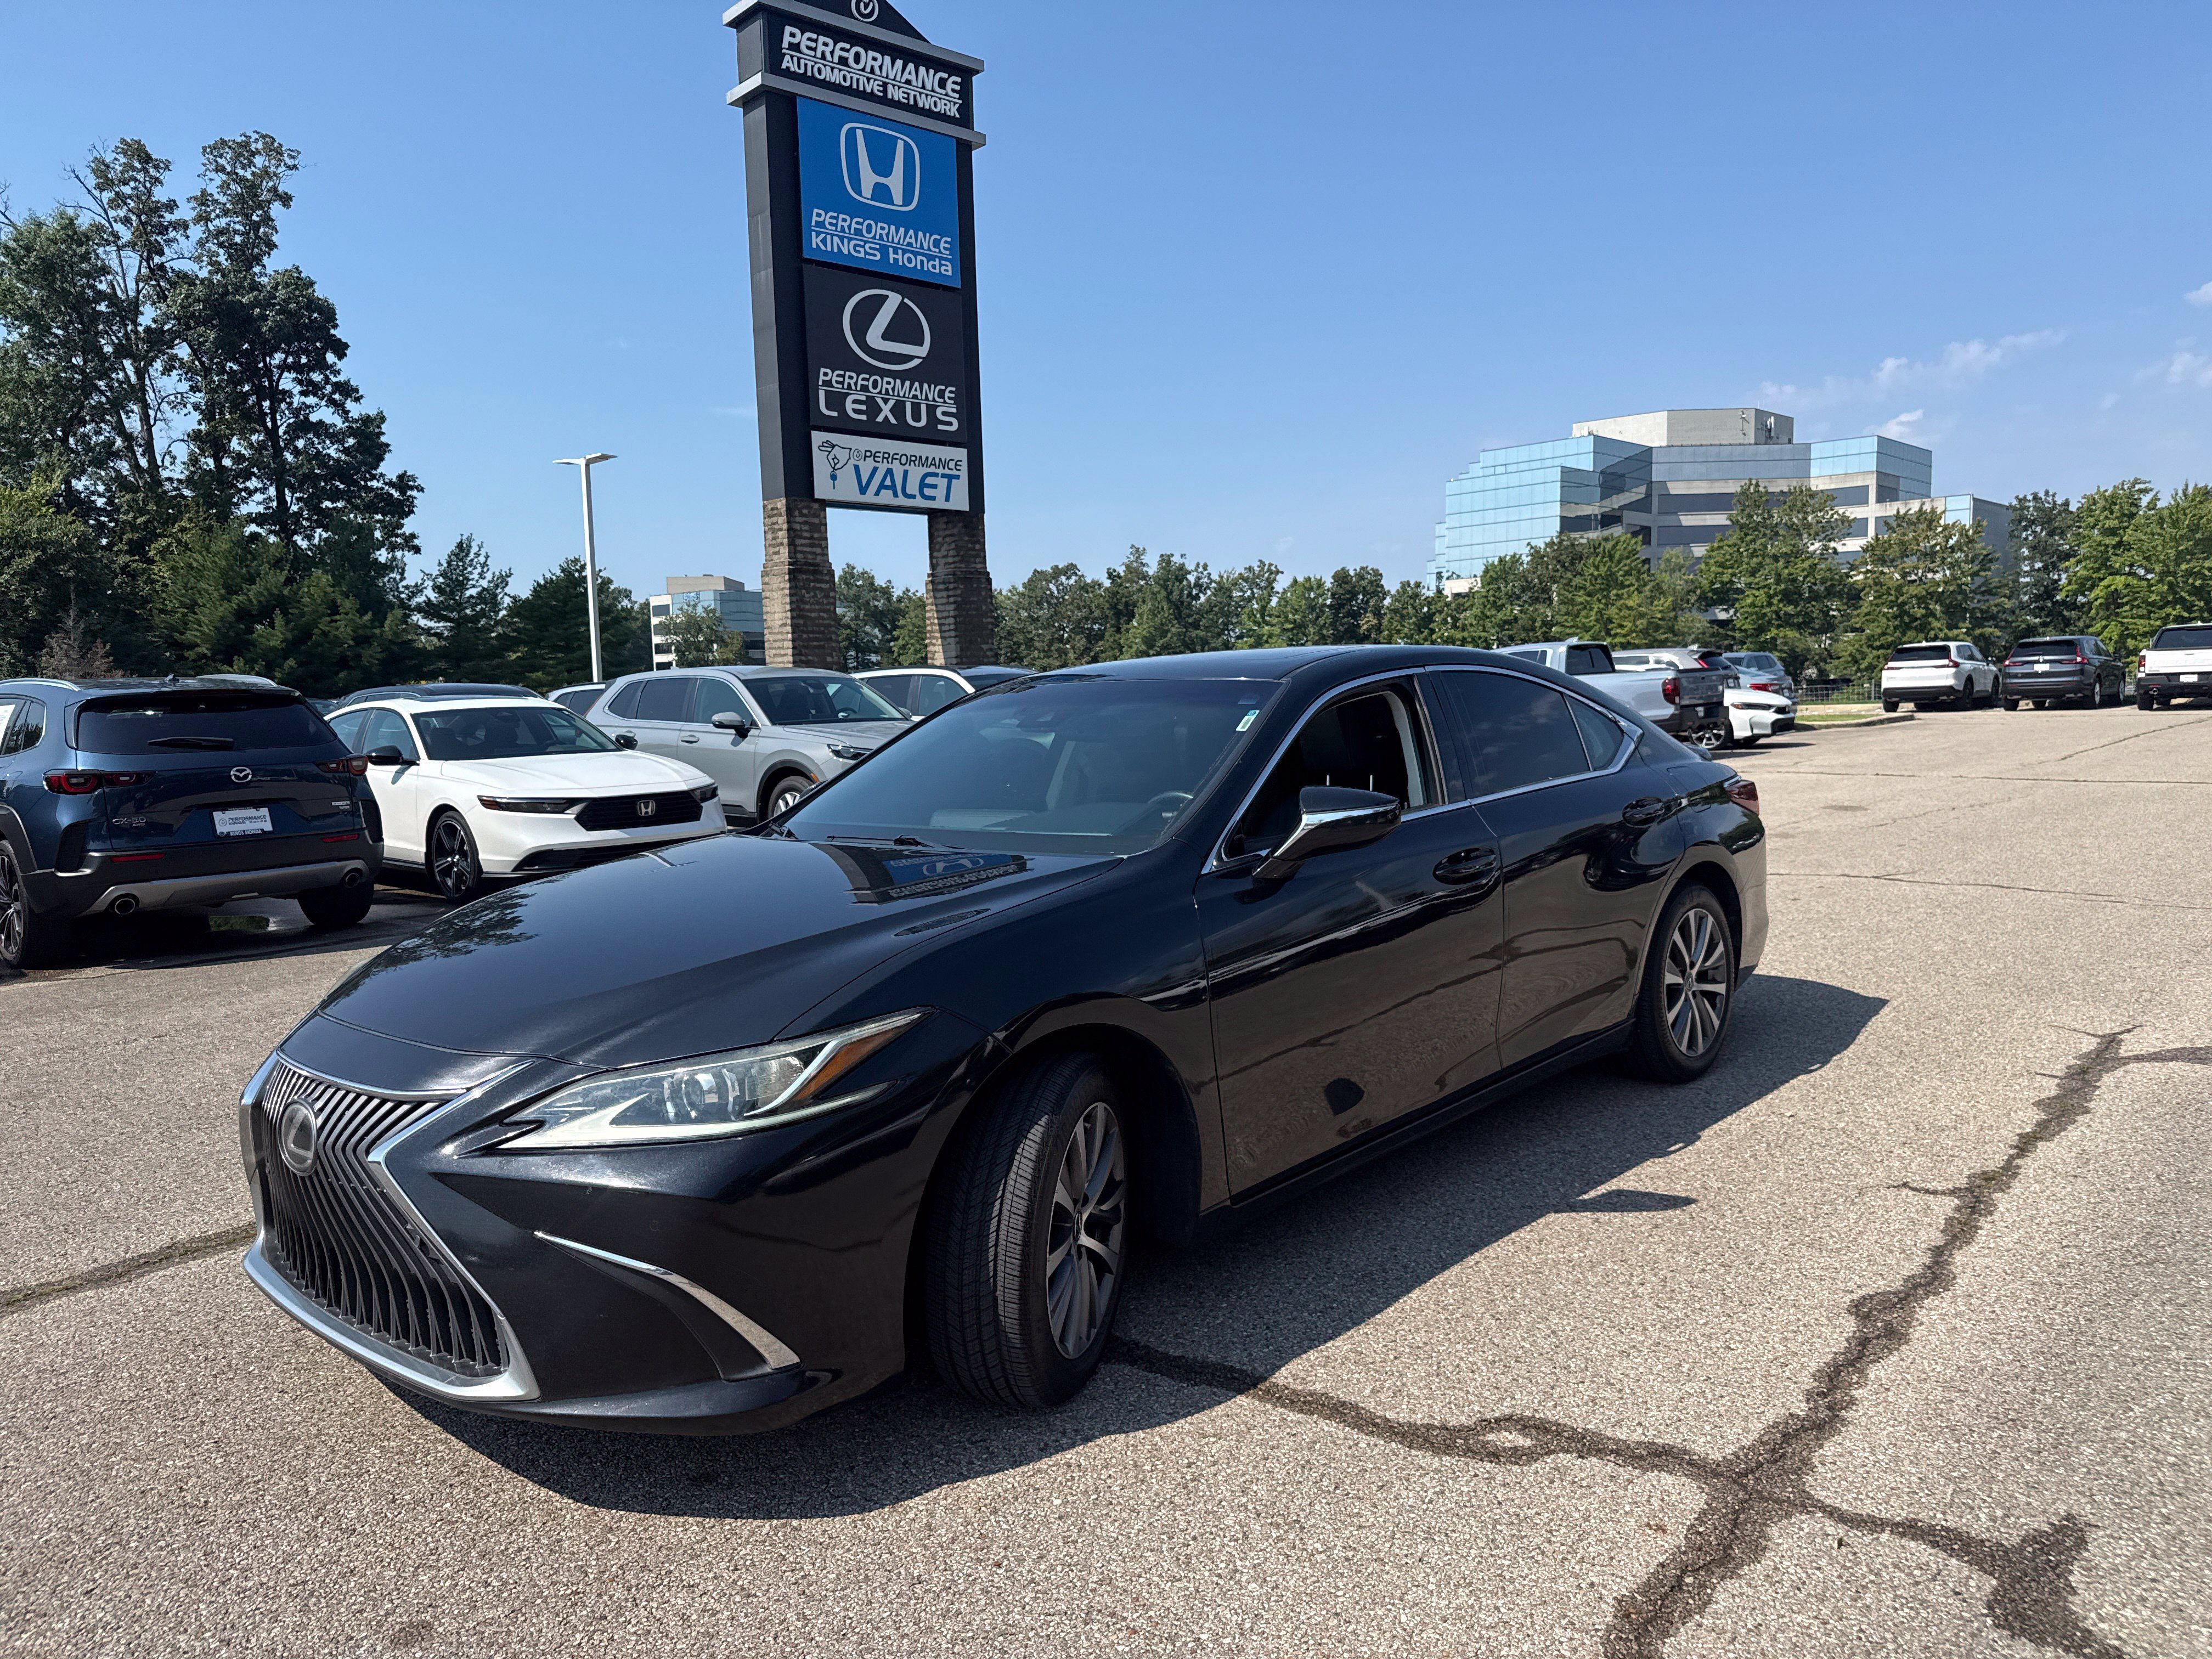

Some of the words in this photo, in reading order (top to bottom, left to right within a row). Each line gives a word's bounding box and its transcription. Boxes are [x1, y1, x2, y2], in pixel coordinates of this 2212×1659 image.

[782, 25, 962, 98] PERFORMANCE
[781, 55, 883, 96] AUTOMOTIVE
[887, 84, 960, 118] NETWORK
[811, 208, 951, 255] PERFORMANCE
[811, 232, 881, 261] KINGS
[889, 247, 952, 276] Honda
[819, 368, 956, 404] PERFORMANCE
[819, 390, 958, 431] LEXUS
[864, 450, 962, 471] PERFORMANCE
[853, 464, 961, 503] VALET
[112, 816, 146, 825] CX-50
